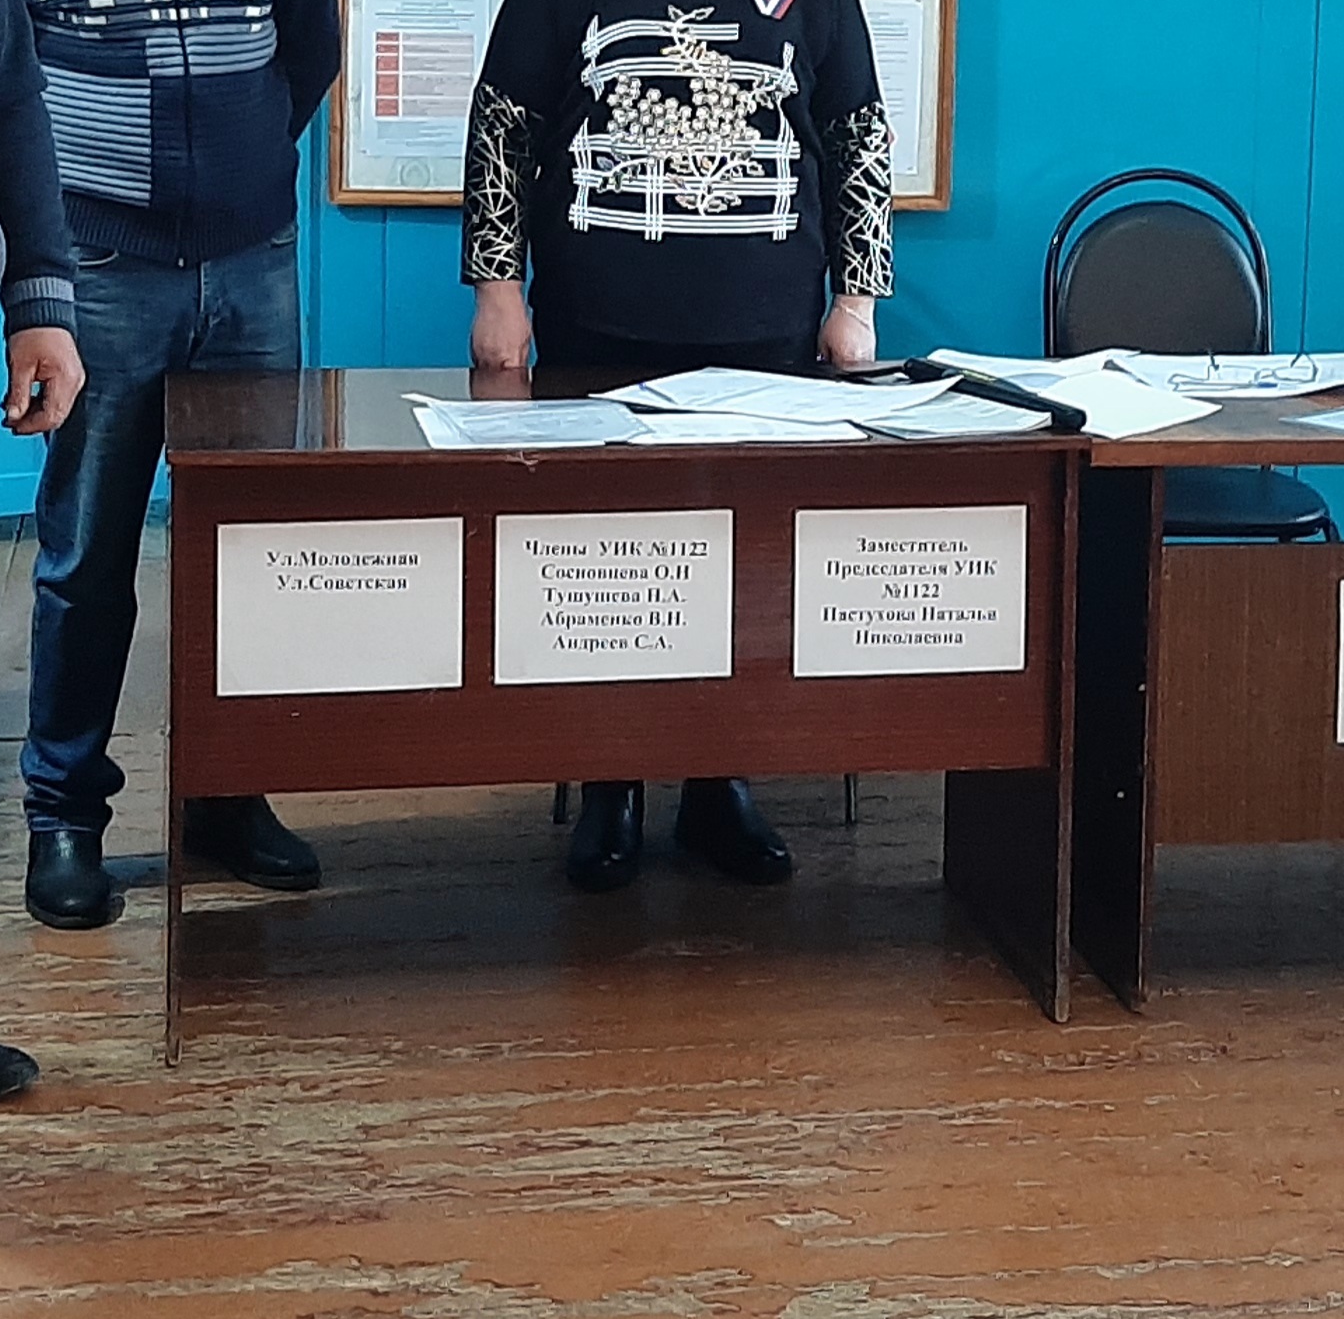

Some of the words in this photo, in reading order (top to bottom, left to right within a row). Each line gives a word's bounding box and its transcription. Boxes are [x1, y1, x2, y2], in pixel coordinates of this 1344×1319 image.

[525, 540, 587, 556] Члены
[599, 540, 643, 557] УИК
[857, 537, 968, 553] Заместитель
[826, 560, 948, 579] Председателя
[955, 560, 998, 576] УИК
[552, 634, 629, 653] Андреев
[855, 629, 964, 645] Николаевна
